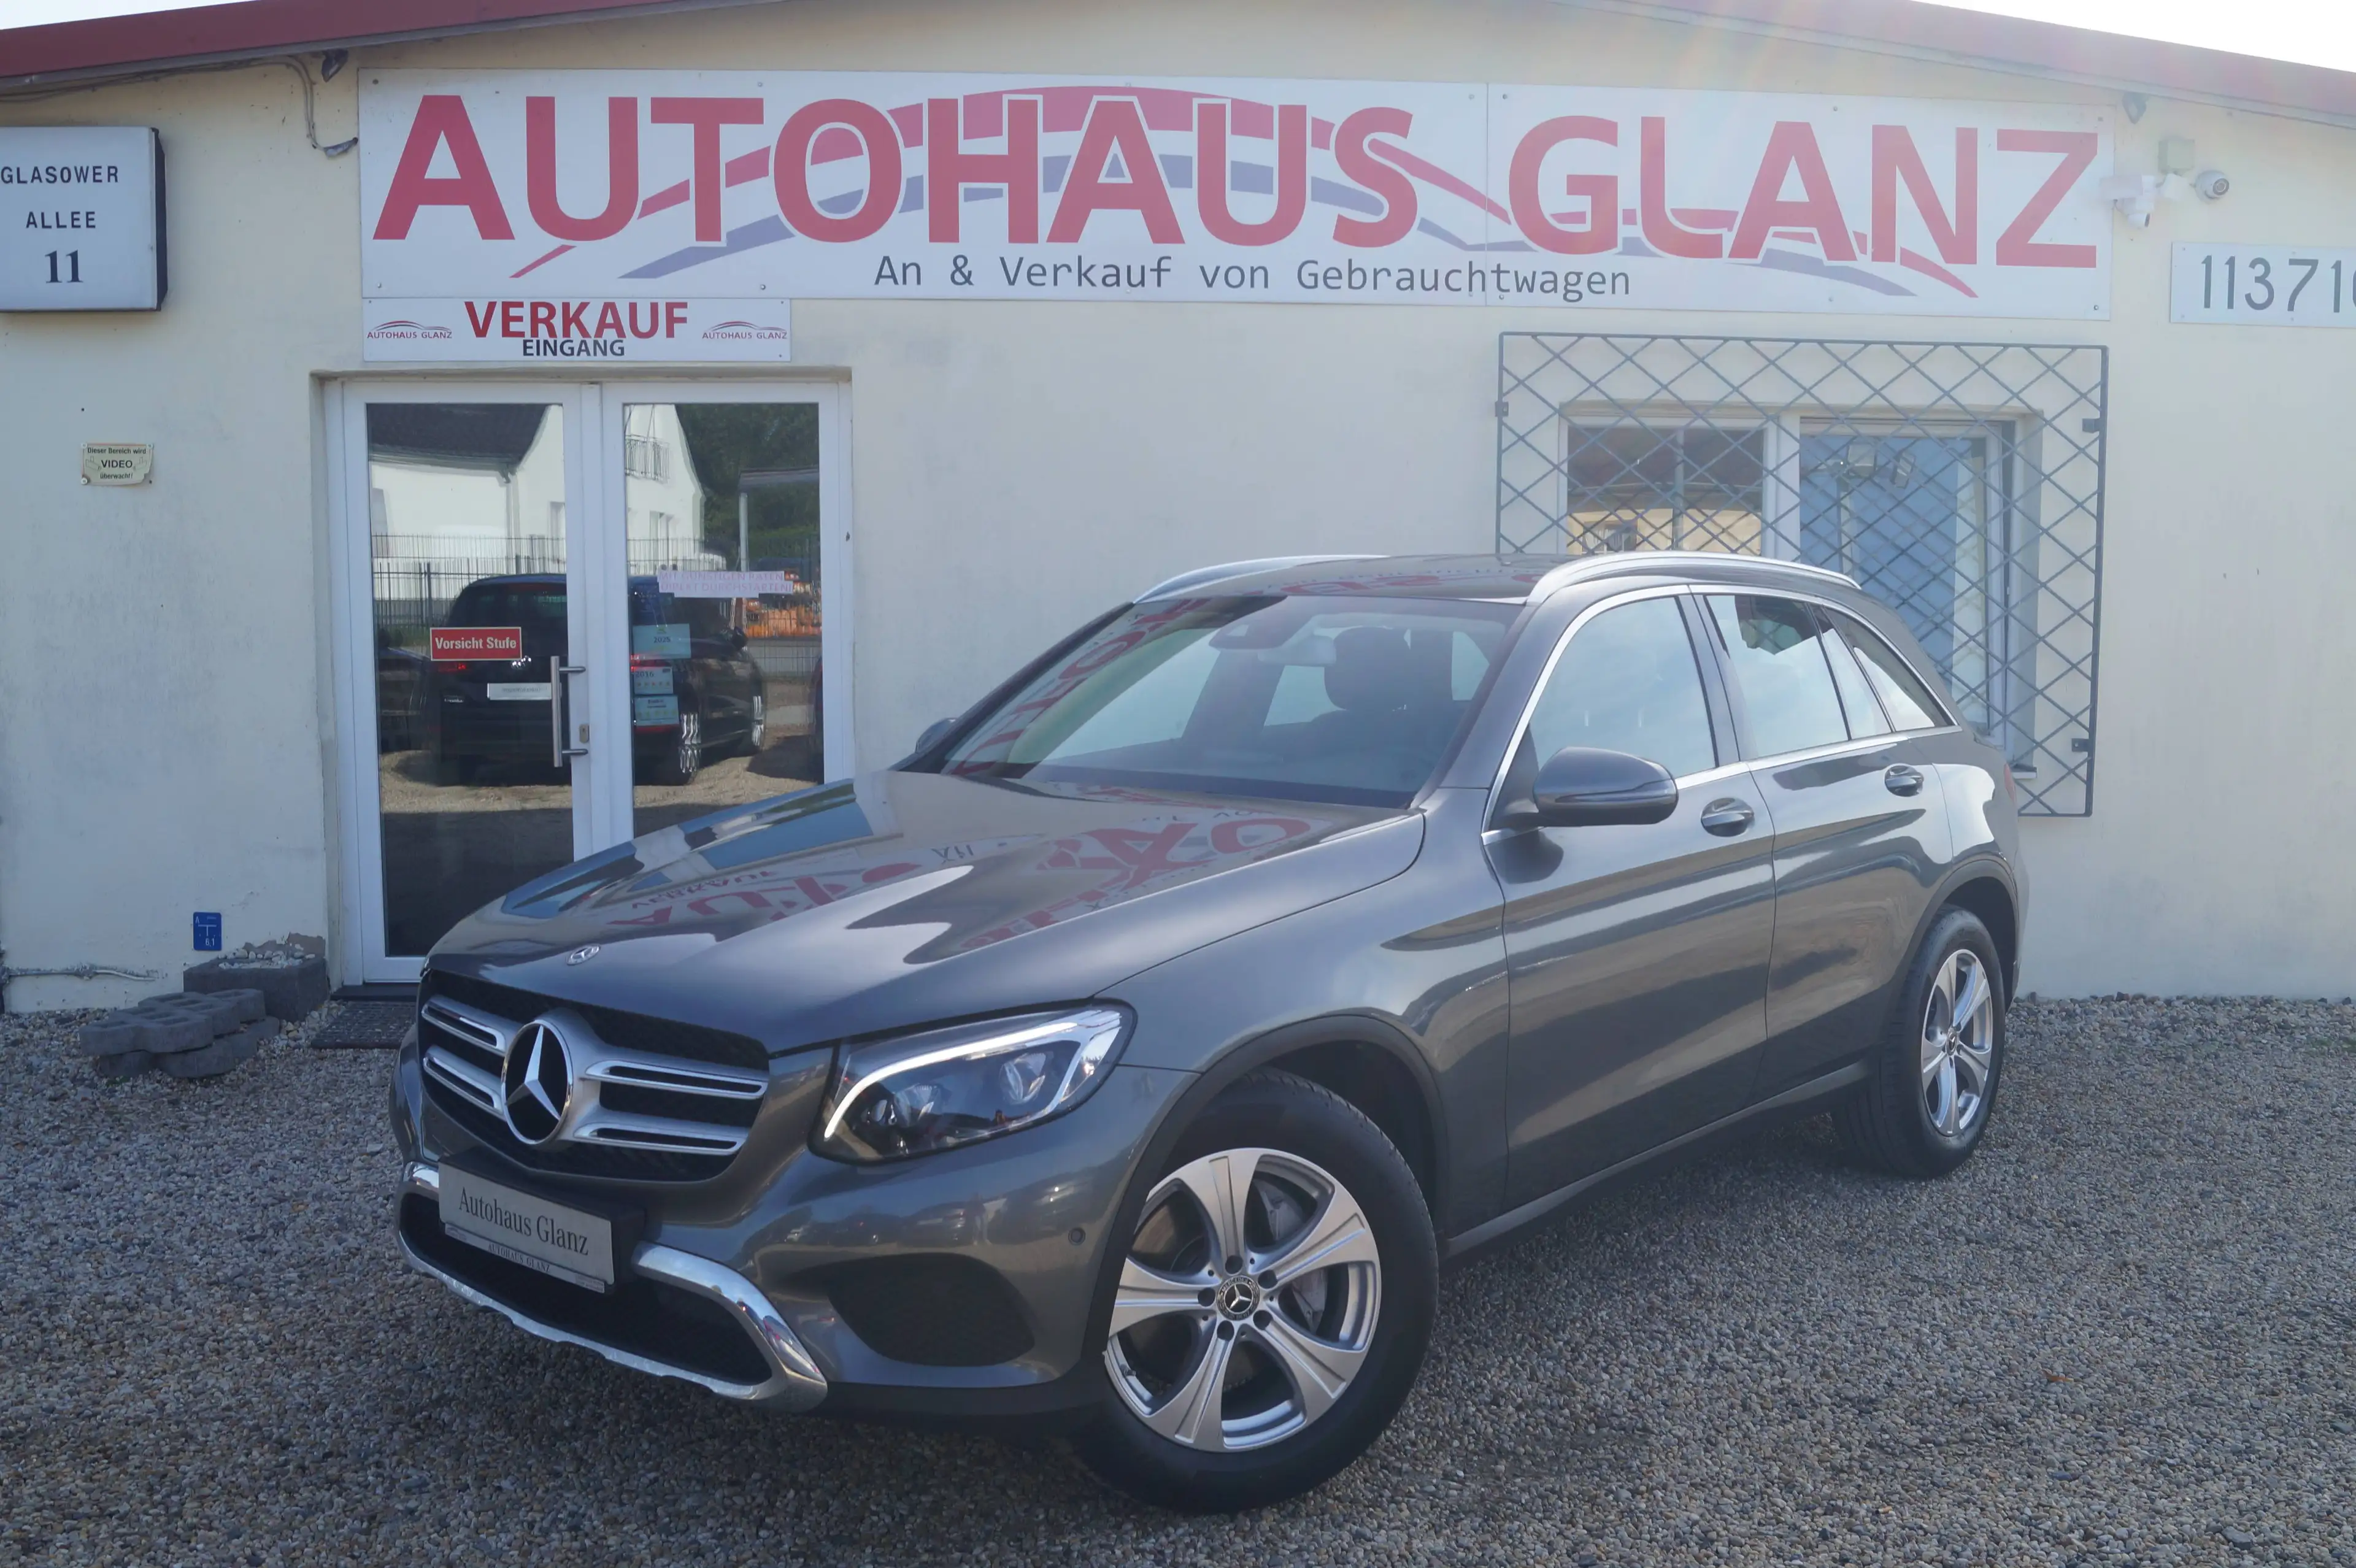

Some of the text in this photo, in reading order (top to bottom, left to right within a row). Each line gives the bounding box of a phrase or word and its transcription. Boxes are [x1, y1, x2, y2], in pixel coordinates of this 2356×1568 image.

[1, 166, 118, 183] GLASOWER
[372, 94, 2098, 269] AUTOHAUS GLANZ
[26, 212, 96, 228] ALLEE
[45, 250, 83, 283] 11
[874, 254, 1630, 302] An & Verkauf von Gebrauchtwagen
[2201, 255, 2356, 313] 11371
[464, 301, 688, 339] VERKAUF
[367, 331, 452, 339] AUTOHAUS GLANZ
[702, 331, 787, 340] AUTOHAUS GLANZ
[522, 339, 625, 356] EINGANG
[101, 459, 133, 468] VIDEO
[435, 636, 517, 650] Vorsicht Stufe
[459, 1186, 588, 1256] Autohaus Glanz
[488, 1243, 550, 1273] AUTOHAUS GLANZ
